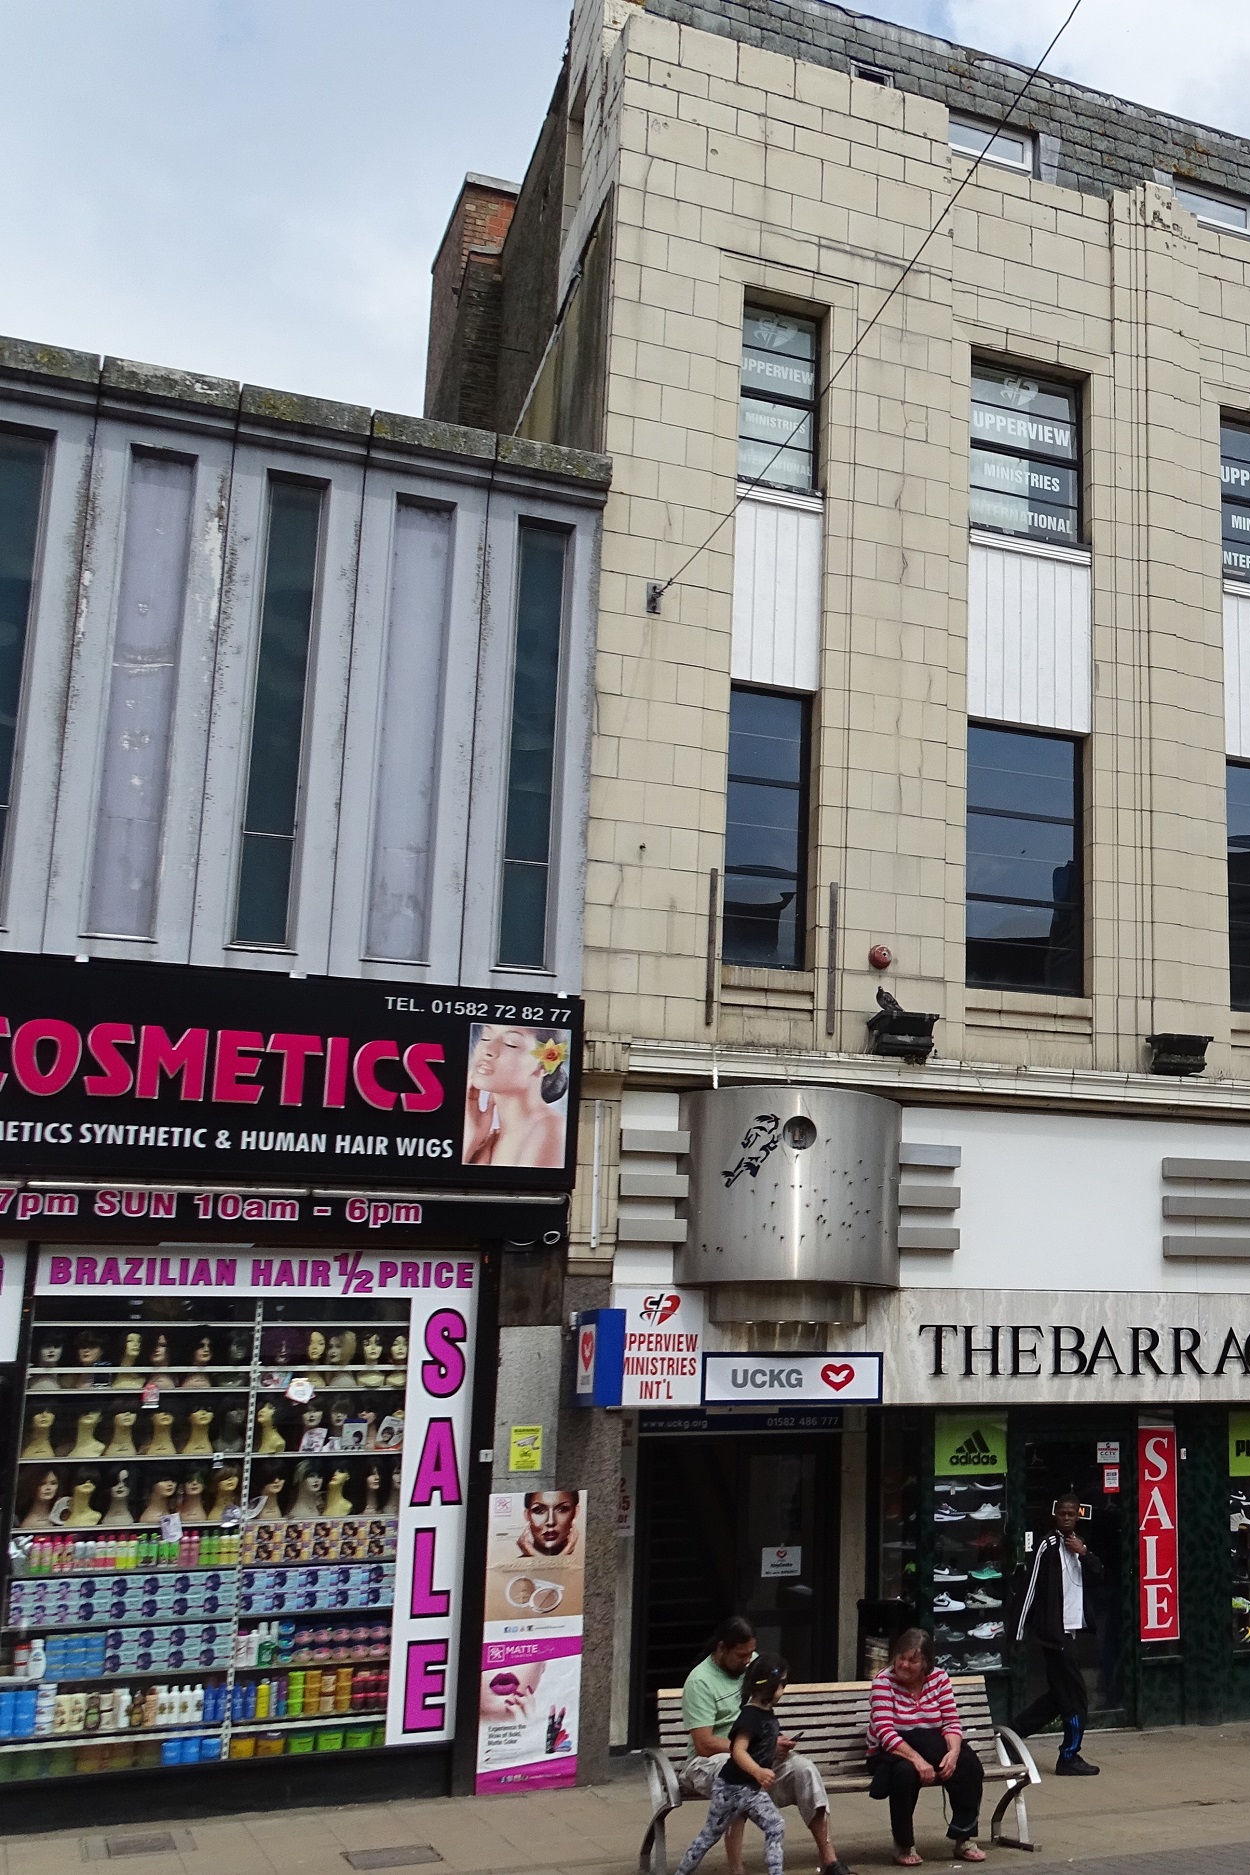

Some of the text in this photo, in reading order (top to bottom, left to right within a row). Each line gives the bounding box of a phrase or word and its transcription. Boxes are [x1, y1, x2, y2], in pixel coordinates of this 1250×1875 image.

[745, 411, 806, 434] MINISTRIES
[973, 409, 1070, 447] UPPERVIEW
[983, 462, 1060, 492] MINISTRIES
[384, 996, 572, 1023] TEL. 01582 72 82 77
[0, 1016, 446, 1113] OSMETICS
[0, 1120, 454, 1158] ETICS SYNTHETIC & HUMAN HAIR WIGS
[94, 1190, 178, 1219] SUN
[193, 1192, 299, 1221] 10am
[345, 1198, 423, 1229] 6pm
[49, 1256, 238, 1287] BRAZILIAN
[251, 1259, 331, 1287] HAIR
[378, 1261, 475, 1289] PRICE
[639, 1379, 673, 1399] INT'L
[731, 1368, 804, 1389] UCKG
[641, 1418, 708, 1430] www.uckg.org
[767, 1416, 839, 1427] 01582 486 777
[949, 1451, 997, 1466] adidas
[402, 1307, 467, 1735] SALE
[1139, 1437, 1175, 1630] SALE
[505, 1643, 539, 1655] MATTE
